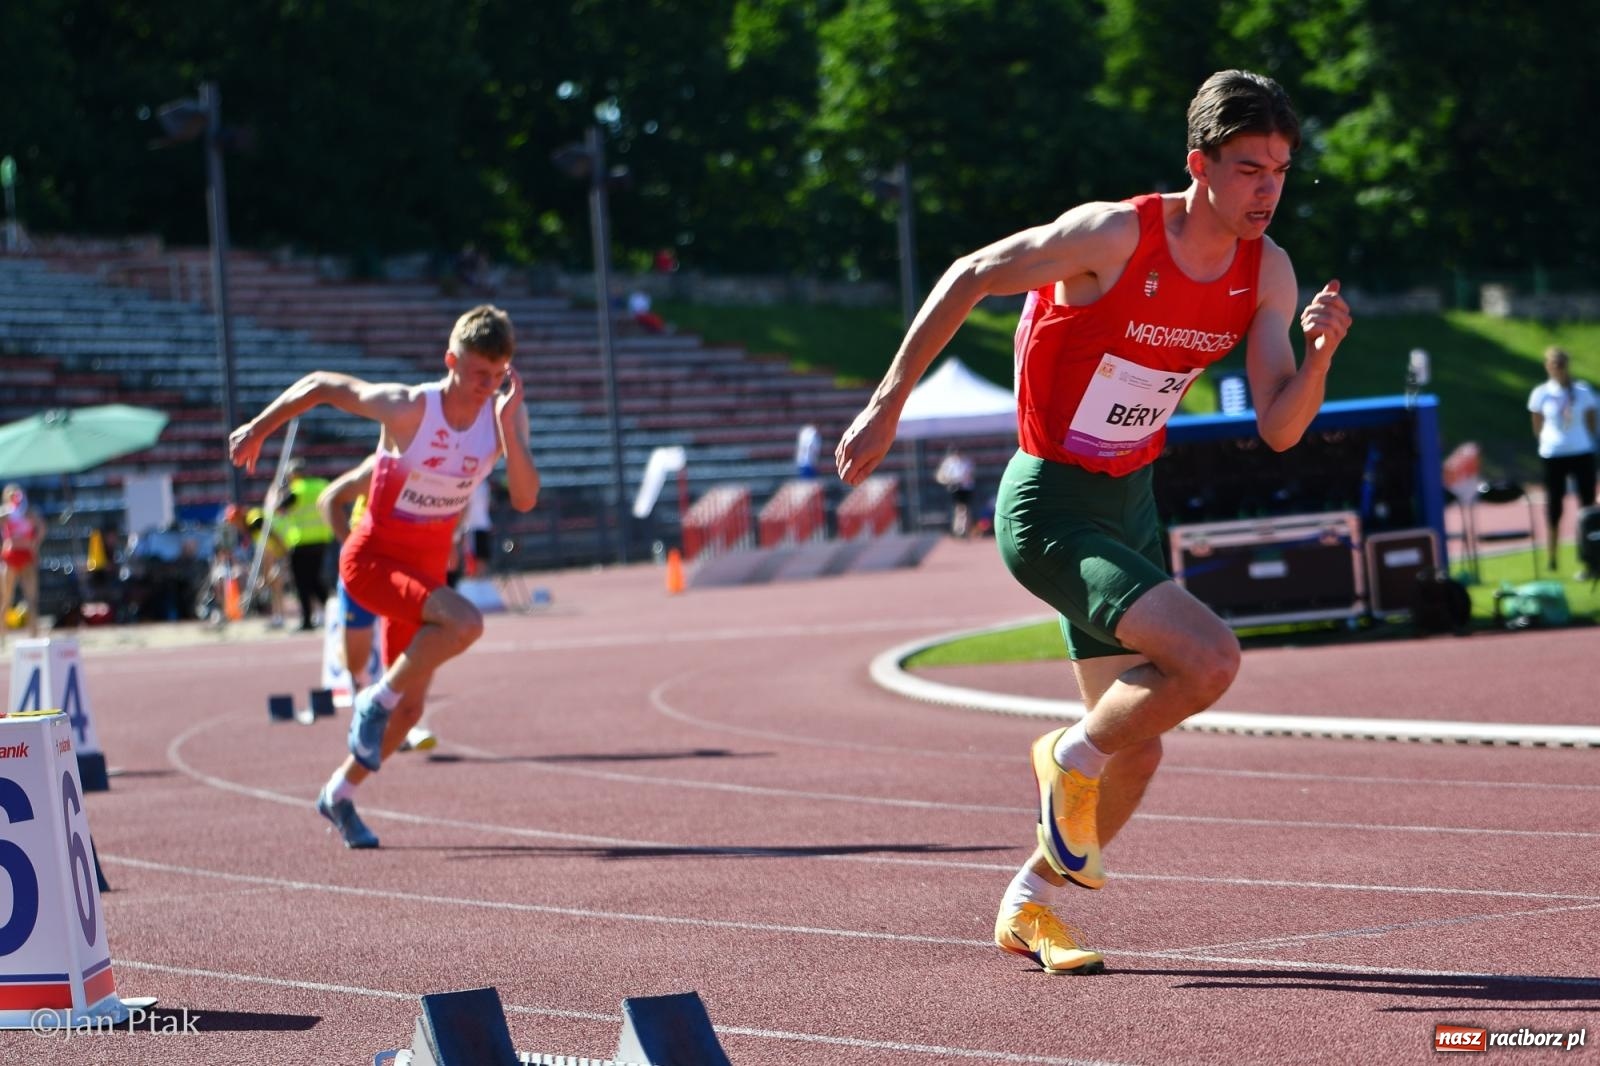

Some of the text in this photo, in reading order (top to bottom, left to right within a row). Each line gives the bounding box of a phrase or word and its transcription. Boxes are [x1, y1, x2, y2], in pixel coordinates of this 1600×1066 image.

[1106, 403, 1166, 427] BÉRY
[62, 662, 88, 744] 4
[62, 770, 97, 948] 6
